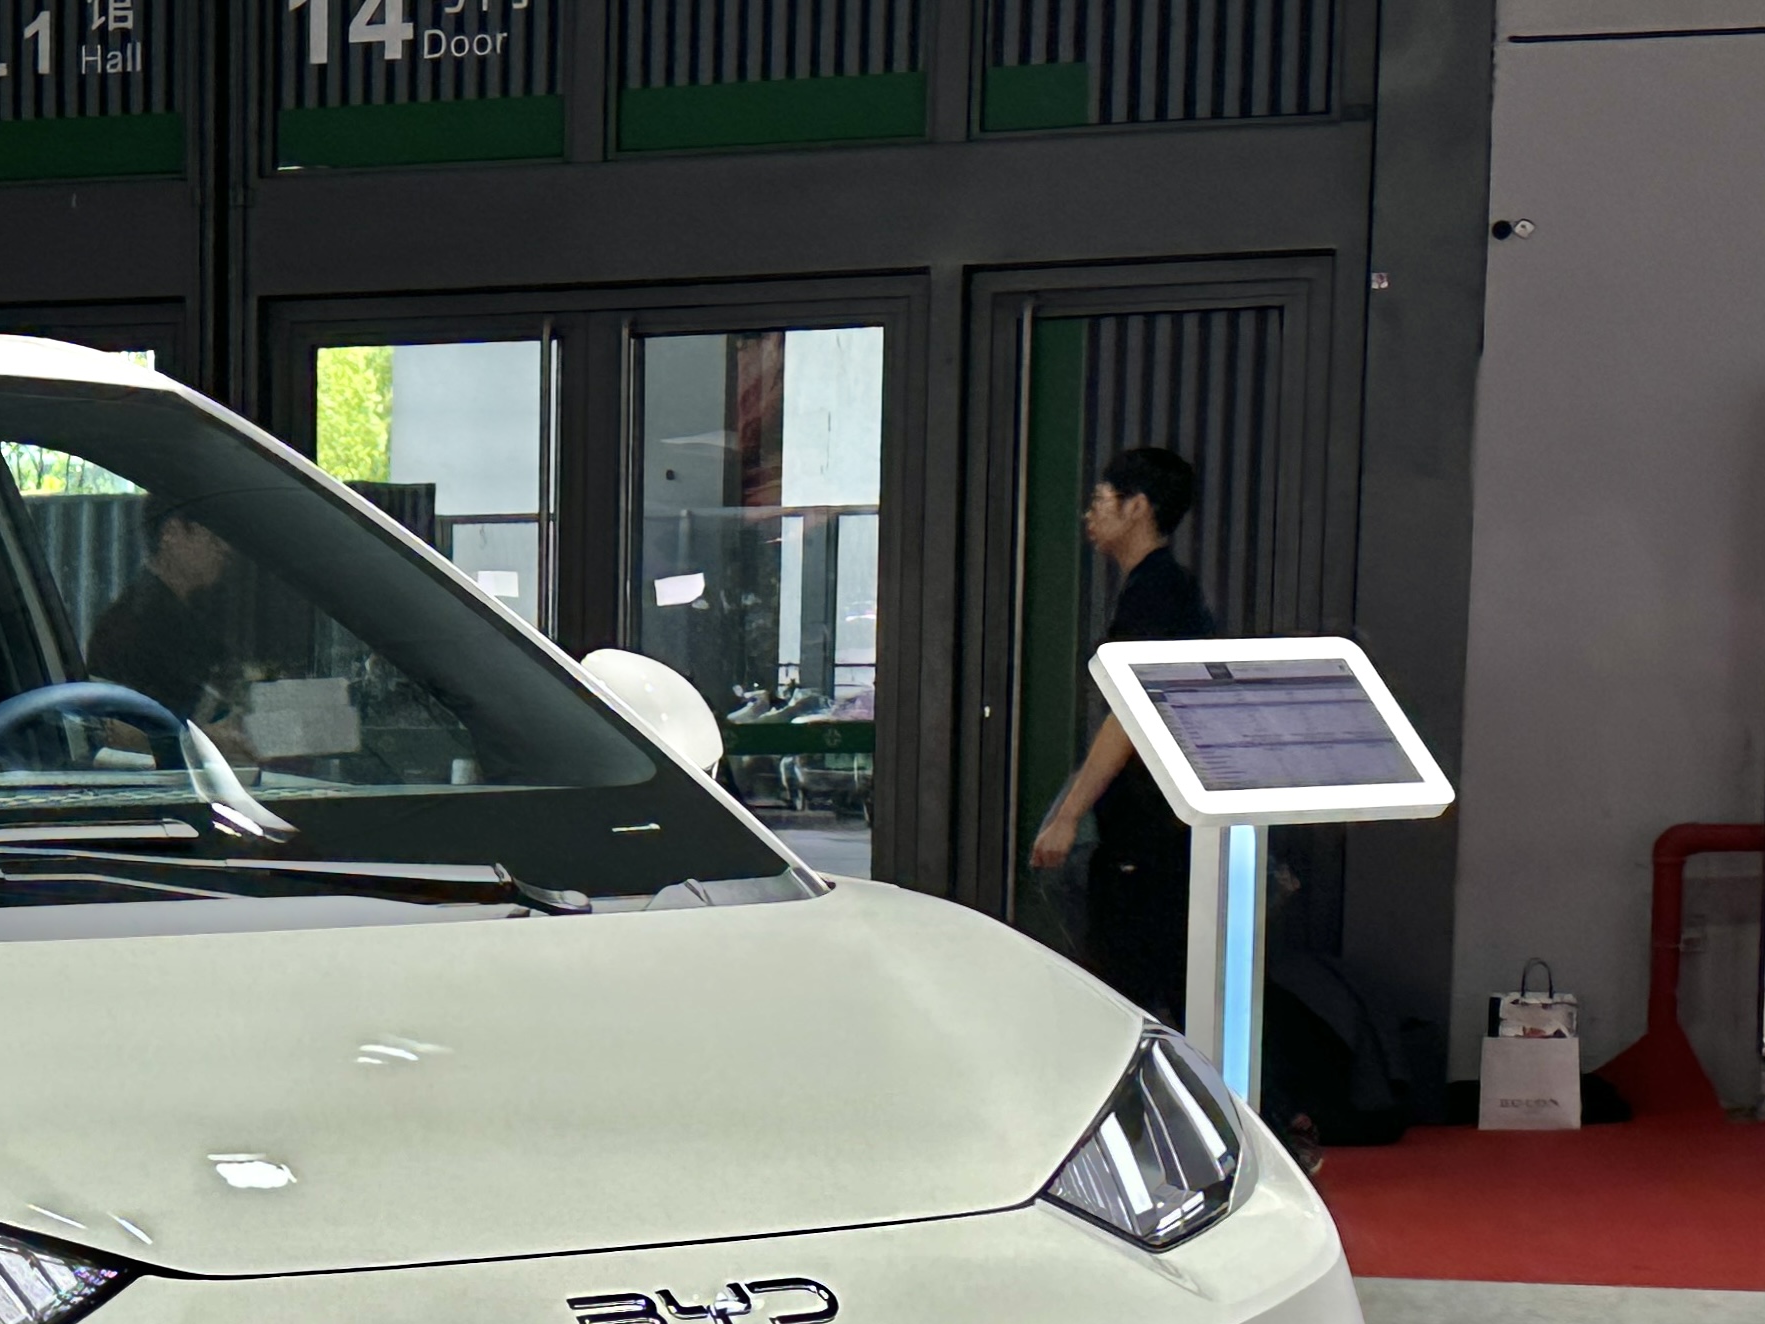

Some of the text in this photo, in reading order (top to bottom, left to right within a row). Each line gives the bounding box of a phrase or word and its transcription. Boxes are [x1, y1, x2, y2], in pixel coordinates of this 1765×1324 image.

[289, 0, 414, 64] 14
[423, 29, 508, 59] Door
[81, 42, 142, 75] Hall
